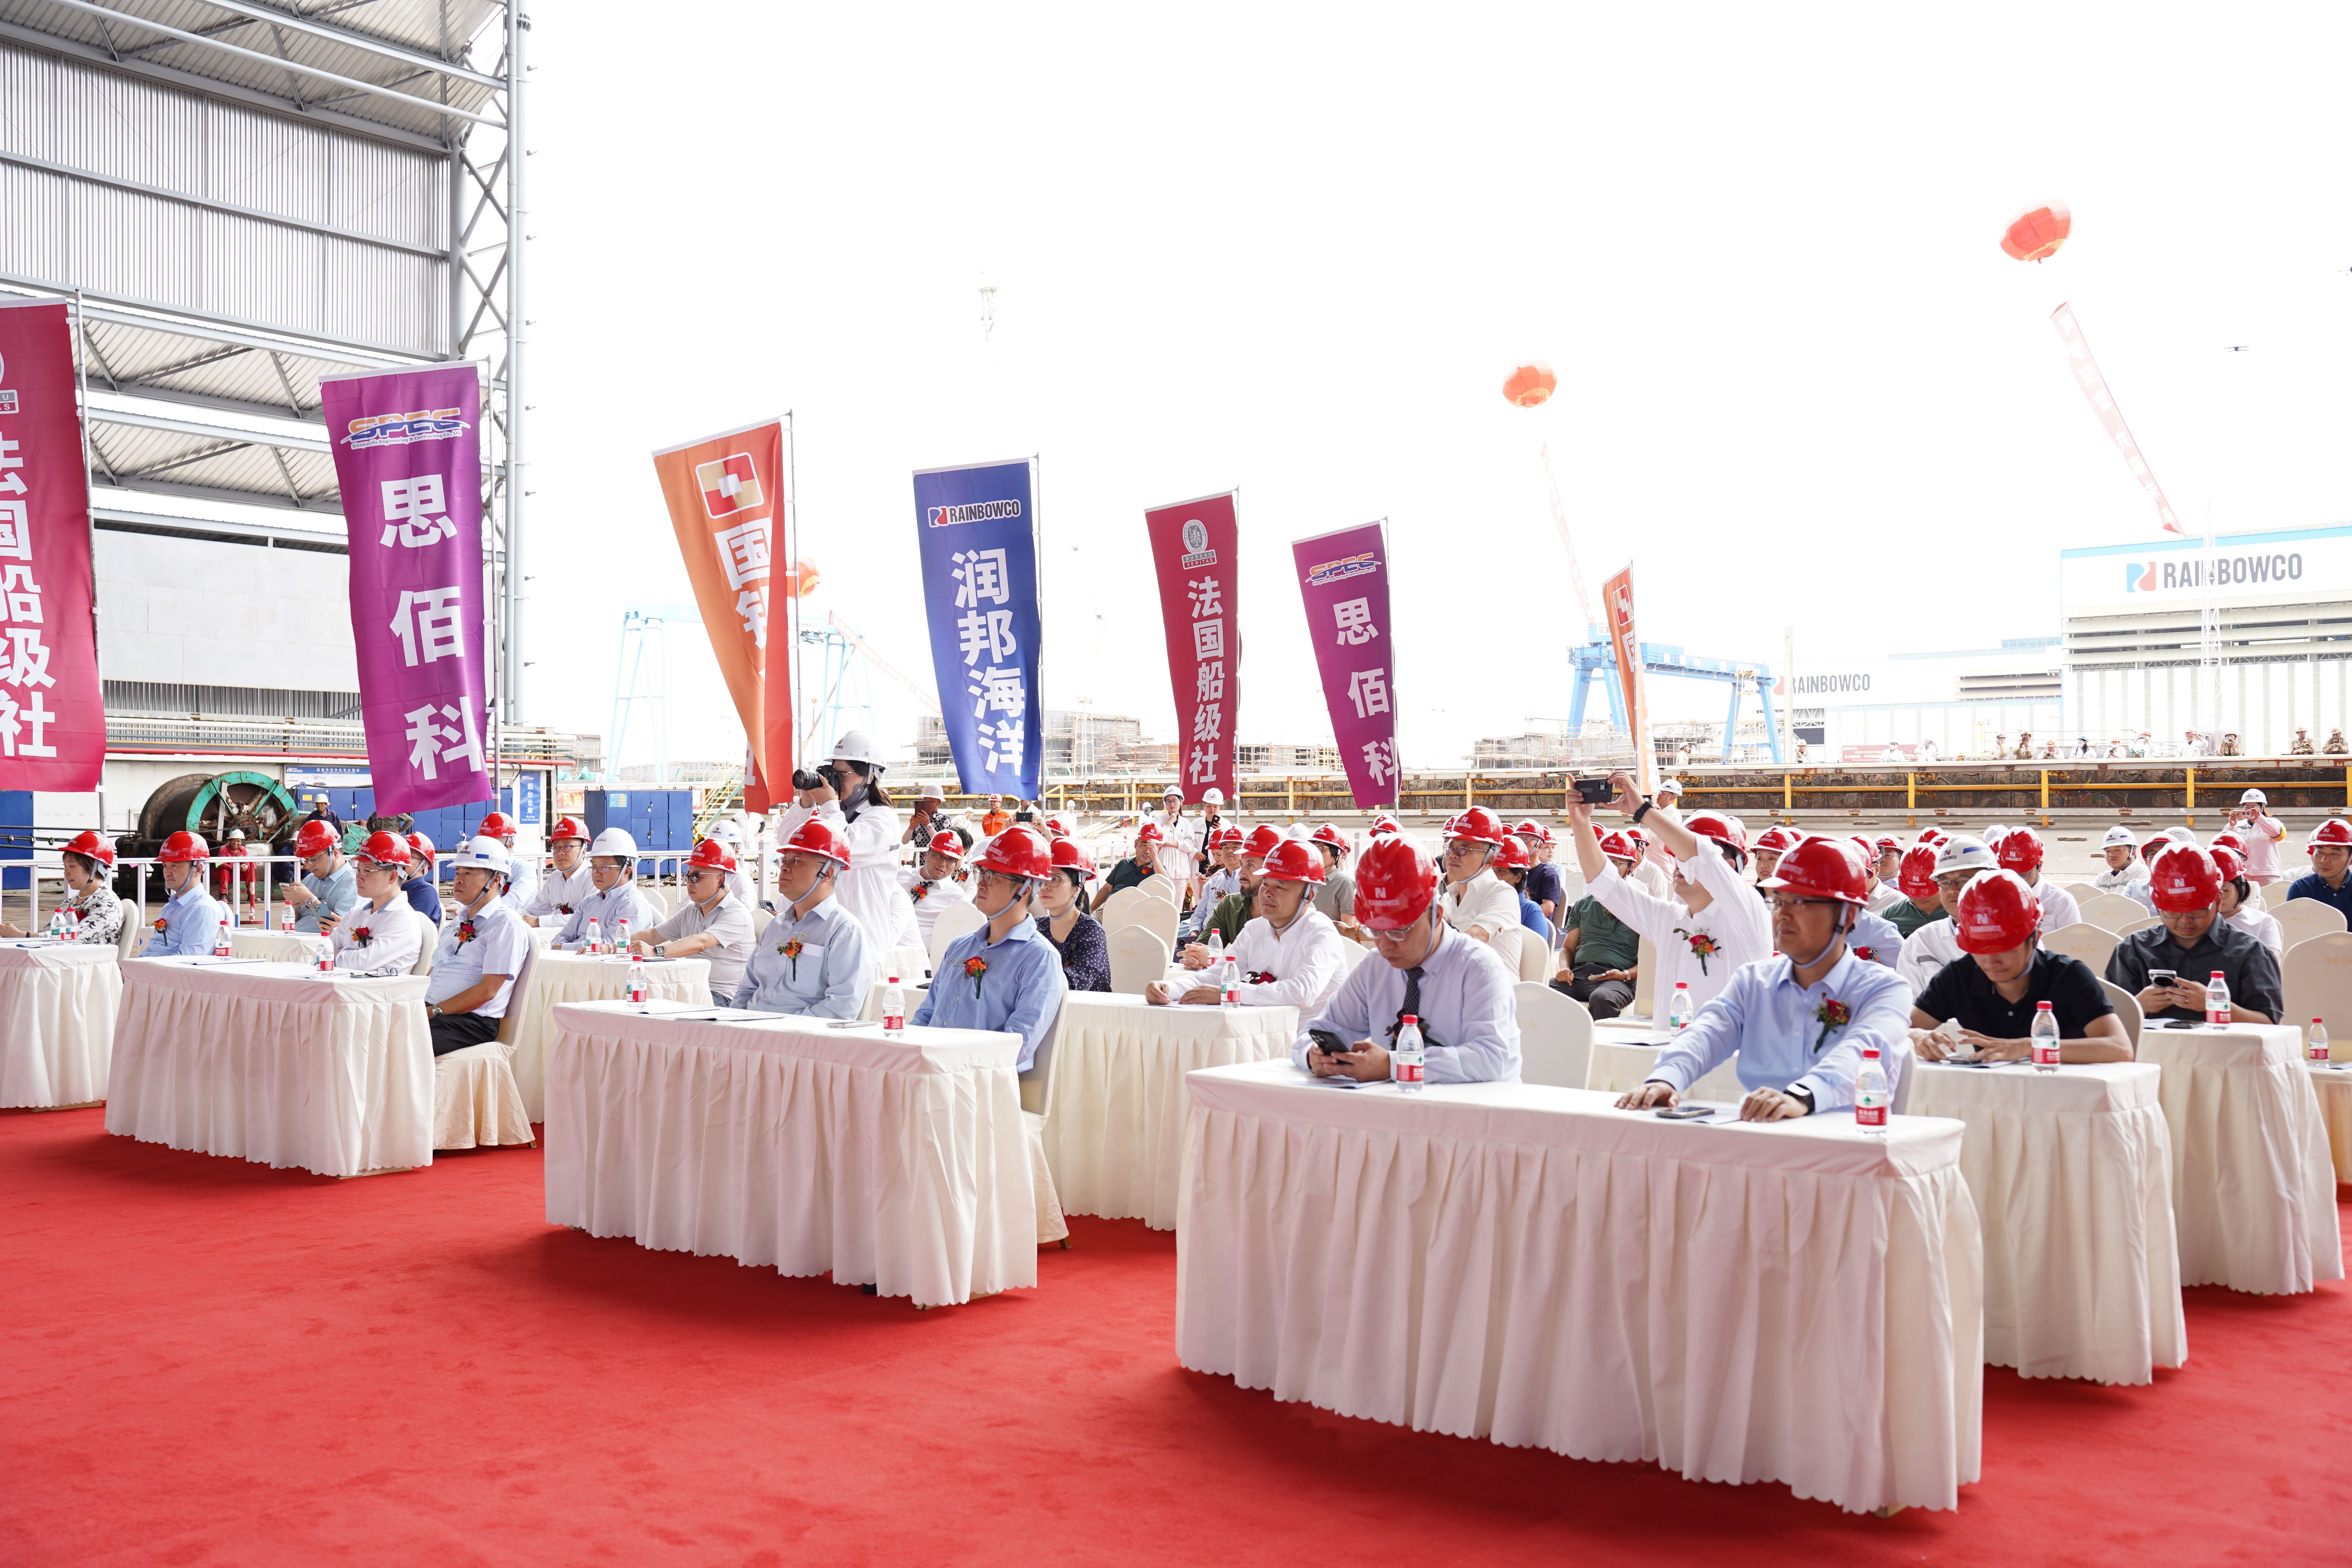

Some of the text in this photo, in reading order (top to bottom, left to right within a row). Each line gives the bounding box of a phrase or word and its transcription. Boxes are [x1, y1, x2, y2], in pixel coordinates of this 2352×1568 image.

[352, 440, 378, 448] Sinopacific
[949, 501, 1019, 523] RAINBOWCO
[1185, 552, 1212, 561] BUREAU
[1187, 558, 1213, 567] VERITAS
[379, 474, 483, 781] 思佰科
[951, 548, 1025, 775] 润邦海洋
[1188, 575, 1225, 785] 法国船级社
[1333, 597, 1401, 786] 思佰科
